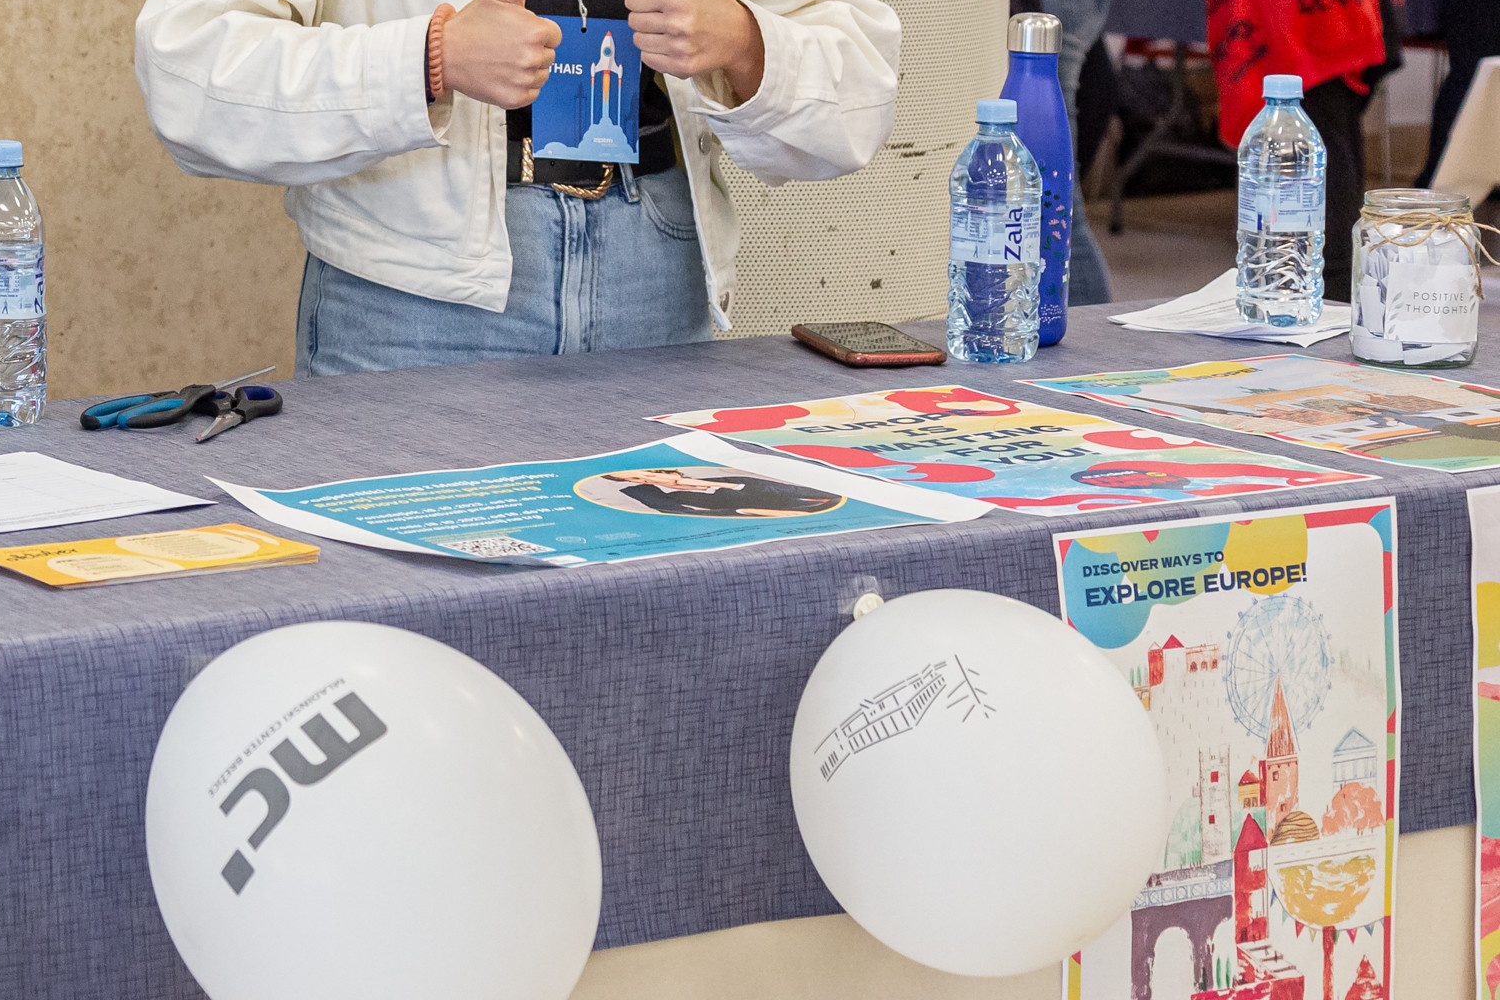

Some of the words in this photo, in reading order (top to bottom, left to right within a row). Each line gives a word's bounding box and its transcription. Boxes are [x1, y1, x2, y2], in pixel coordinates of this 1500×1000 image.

[1004, 206, 1024, 262] Zala
[1405, 304, 1468, 315] THOUGHTS
[1413, 291, 1464, 302] POSITIVE
[792, 408, 988, 434] EUROPE
[891, 425, 958, 437] IS
[850, 425, 1072, 453] WAITING
[944, 440, 1052, 456] FOR
[979, 447, 1102, 465] YOU!
[1083, 558, 1159, 578] DISCOVER
[1161, 553, 1202, 569] WAYS
[1205, 550, 1225, 564] TO
[1085, 577, 1197, 608] EXPLORE
[1204, 562, 1308, 591] EUROPE!
[243, 720, 283, 758] CENTER
